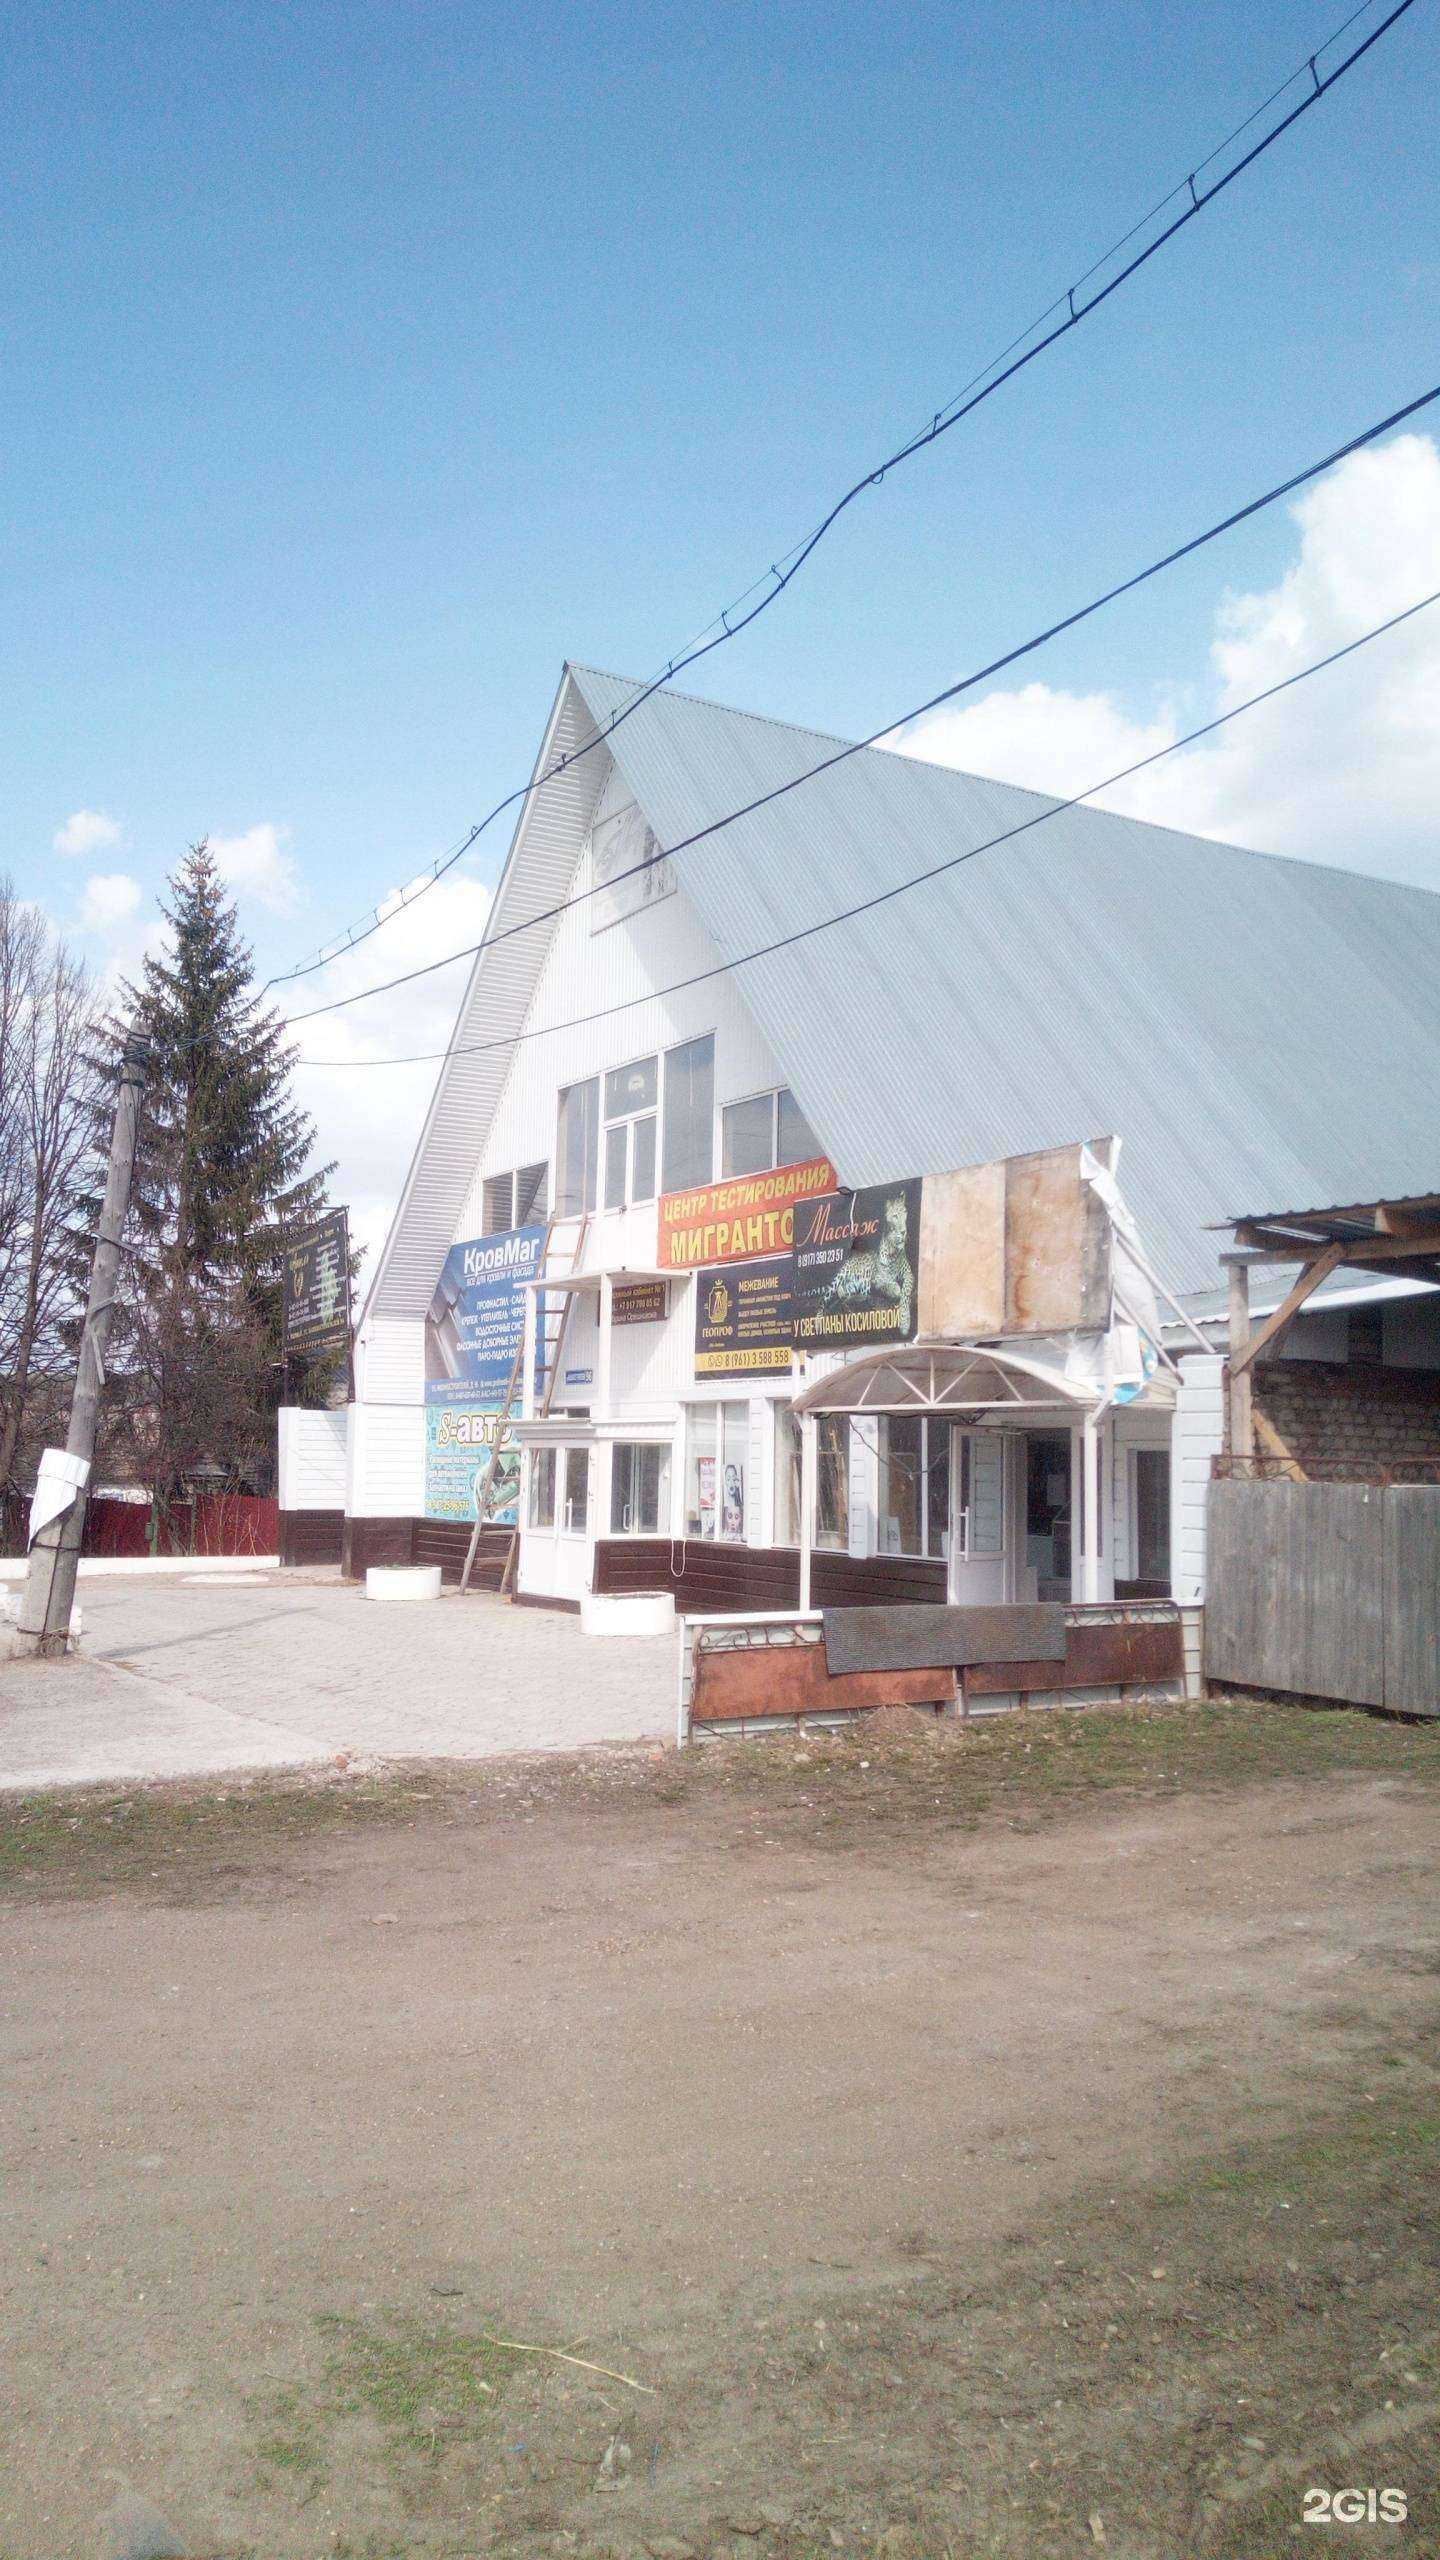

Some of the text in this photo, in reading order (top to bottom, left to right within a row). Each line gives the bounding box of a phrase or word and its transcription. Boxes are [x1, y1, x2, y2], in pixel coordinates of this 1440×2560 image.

[664, 1162, 829, 1223] ЦЕНТР ТЕСТИРОВАНИЯ
[670, 1207, 794, 1265] МИГРАНТО
[797, 1202, 880, 1247] Массаж
[464, 1238, 540, 1276] КровМаг
[738, 1276, 779, 1293] МЕЖЕВАНИЕ
[702, 1326, 733, 1338] ГЕОПРОФ
[794, 1319, 799, 1338] У
[800, 1314, 844, 1337] СВЕТЛАНЫ
[846, 1305, 901, 1332] КОСИЛОВОЙ
[731, 1352, 750, 1367] (961)
